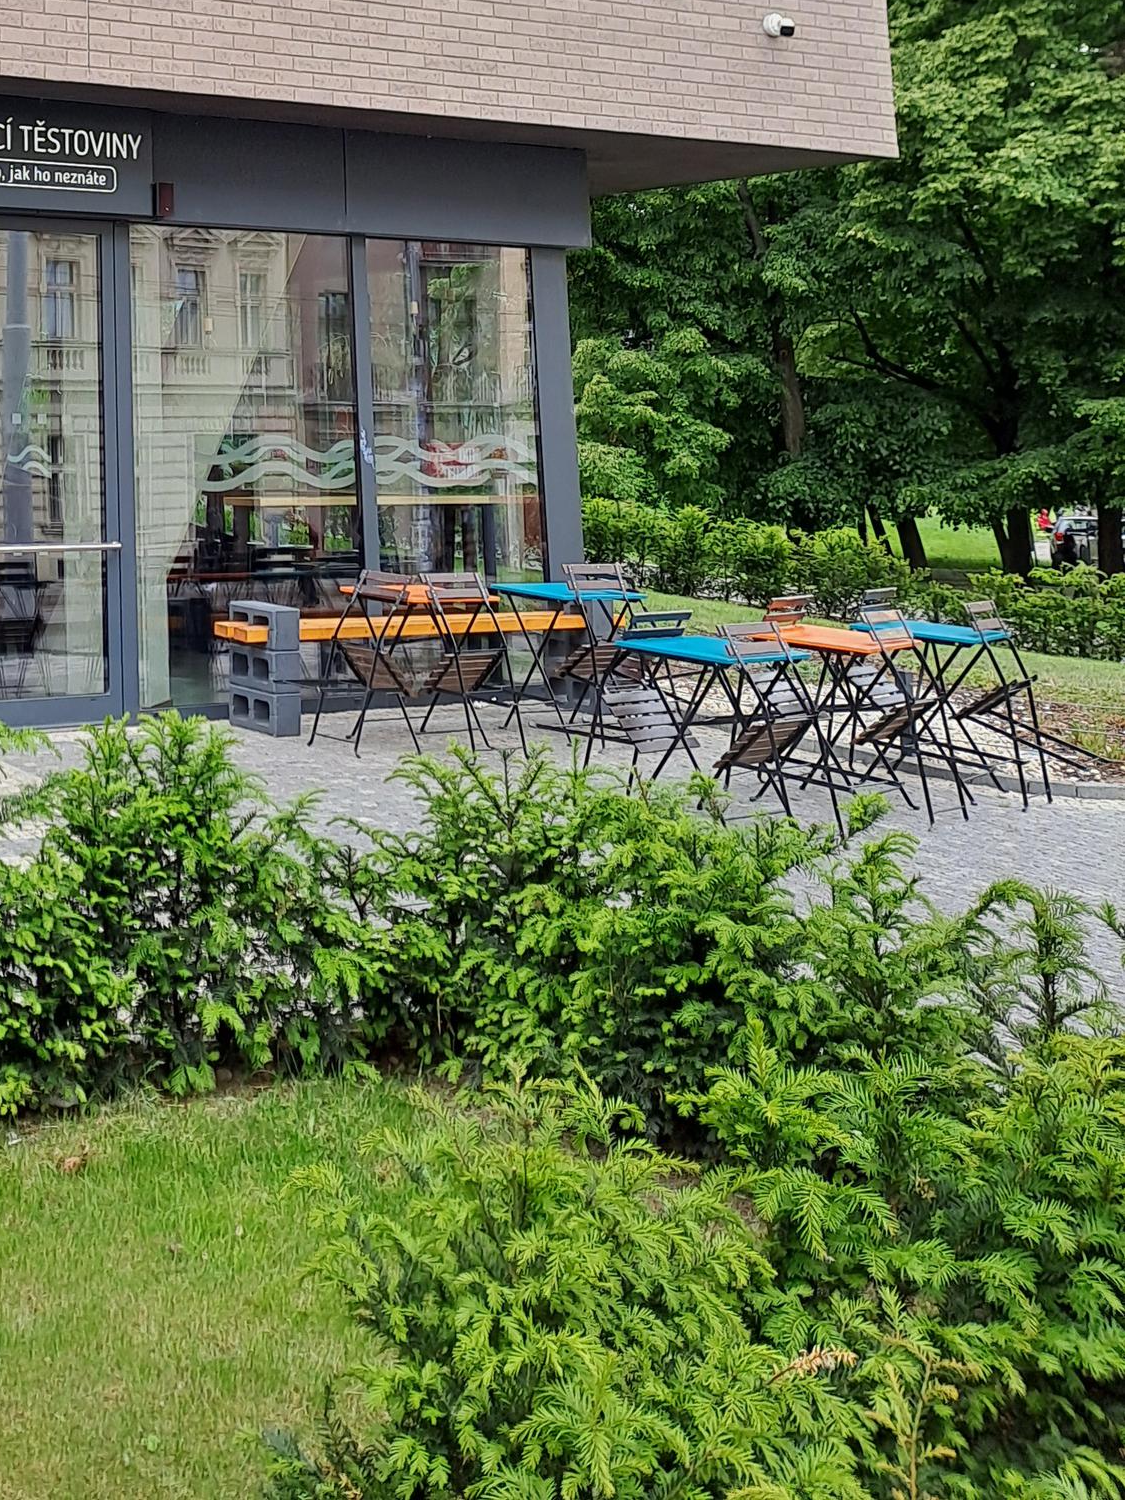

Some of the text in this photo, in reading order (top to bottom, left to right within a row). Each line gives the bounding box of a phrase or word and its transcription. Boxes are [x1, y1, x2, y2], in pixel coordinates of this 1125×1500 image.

[19, 120, 143, 160] TĚSTOVINY
[8, 164, 31, 184] jak
[34, 167, 53, 183] ho
[55, 169, 107, 186] neznáte
